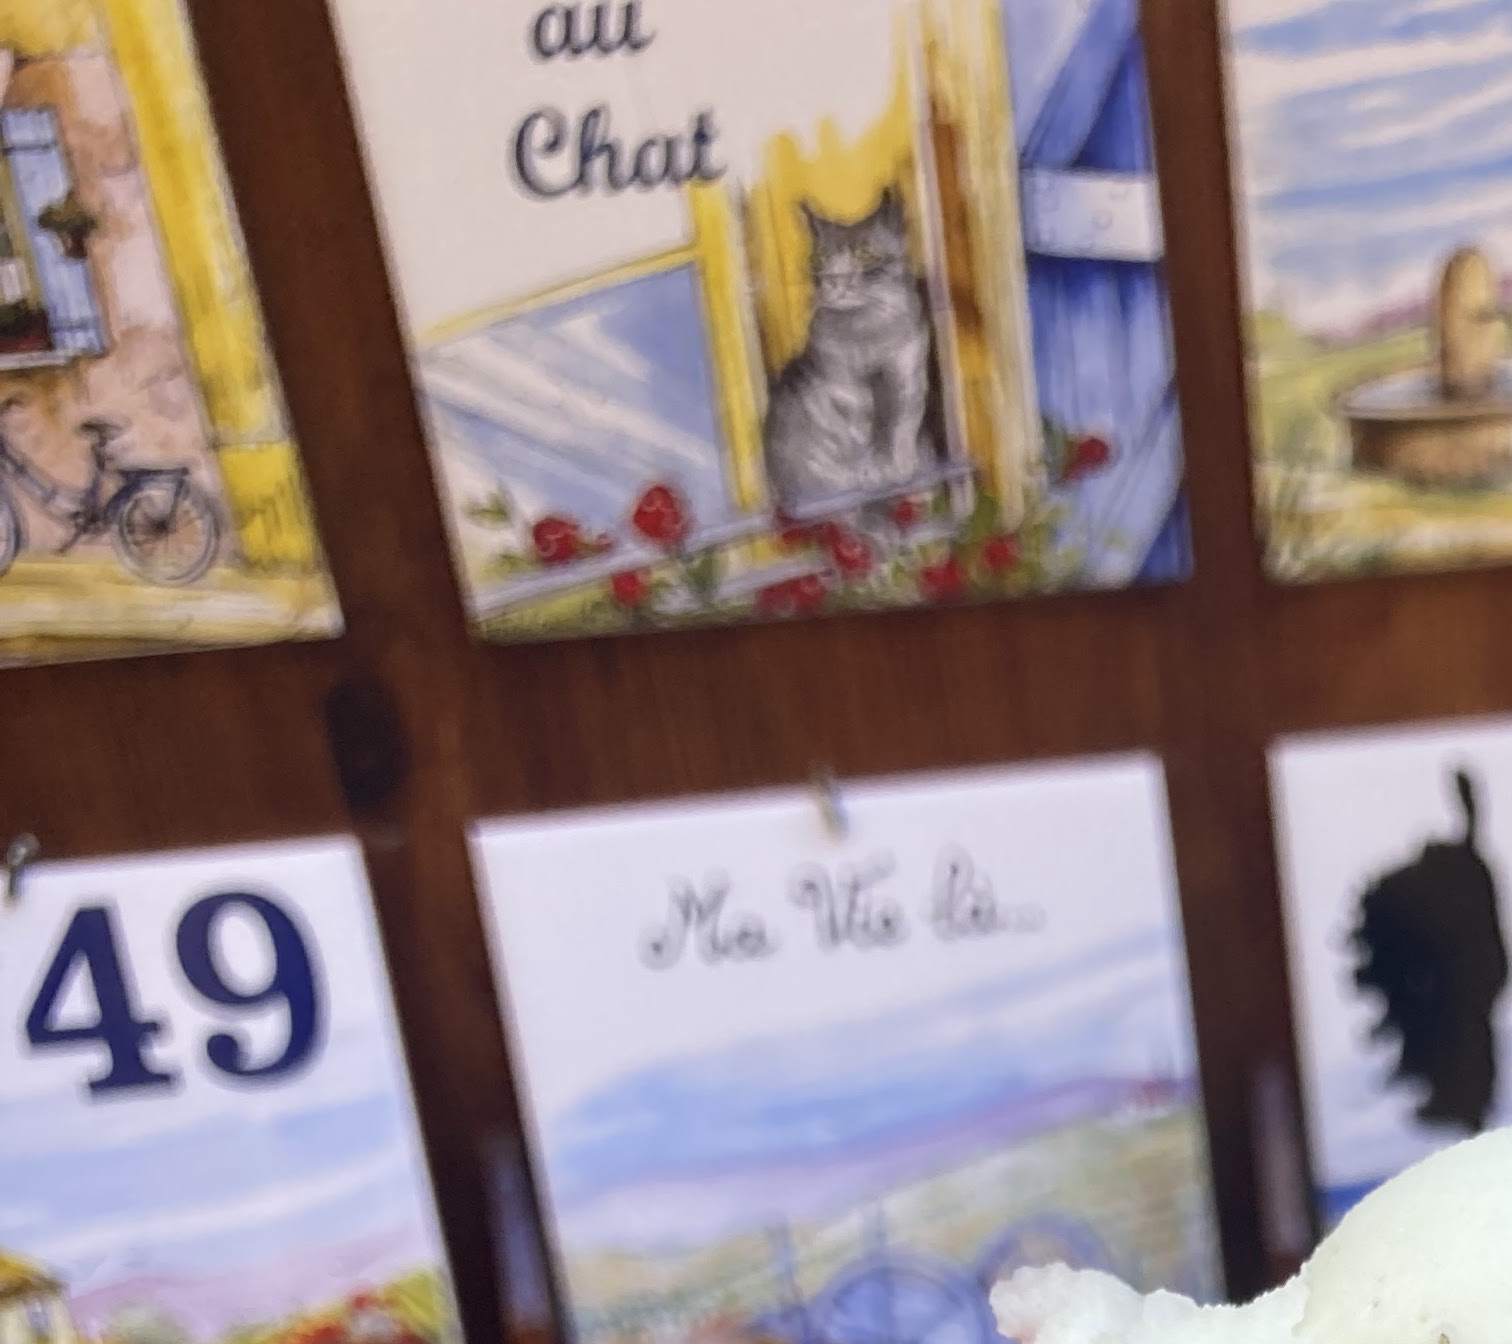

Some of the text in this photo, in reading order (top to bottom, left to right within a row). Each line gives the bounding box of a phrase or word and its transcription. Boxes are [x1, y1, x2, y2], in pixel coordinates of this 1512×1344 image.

[508, 104, 727, 200] Chat
[637, 868, 780, 970] Ma
[26, 892, 325, 1094] 49
